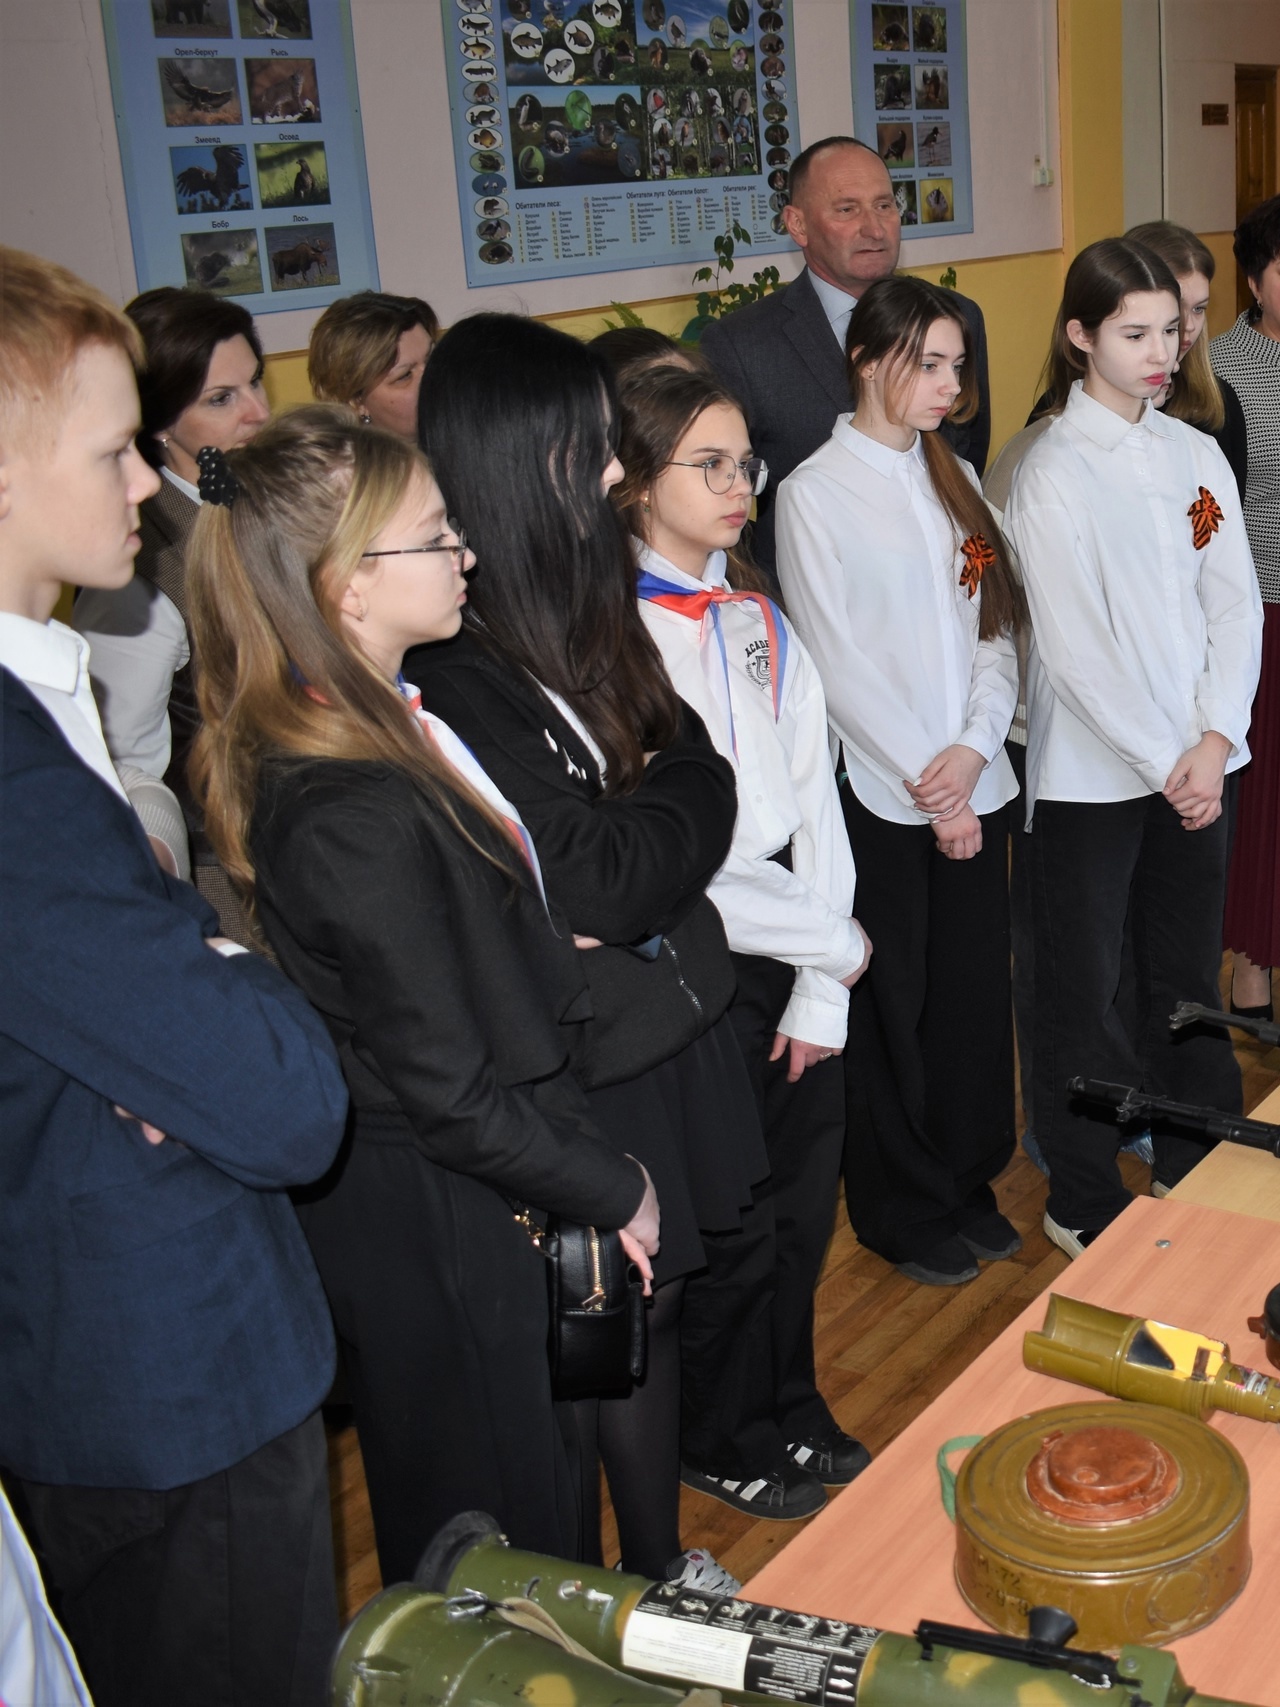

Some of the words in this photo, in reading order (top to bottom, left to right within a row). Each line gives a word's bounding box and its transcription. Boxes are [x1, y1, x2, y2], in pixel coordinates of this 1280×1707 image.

[270, 48, 288, 56] Рысь
[278, 133, 300, 141] Осоед
[212, 220, 230, 228] Бобр
[744, 640, 770, 658] ACADE
